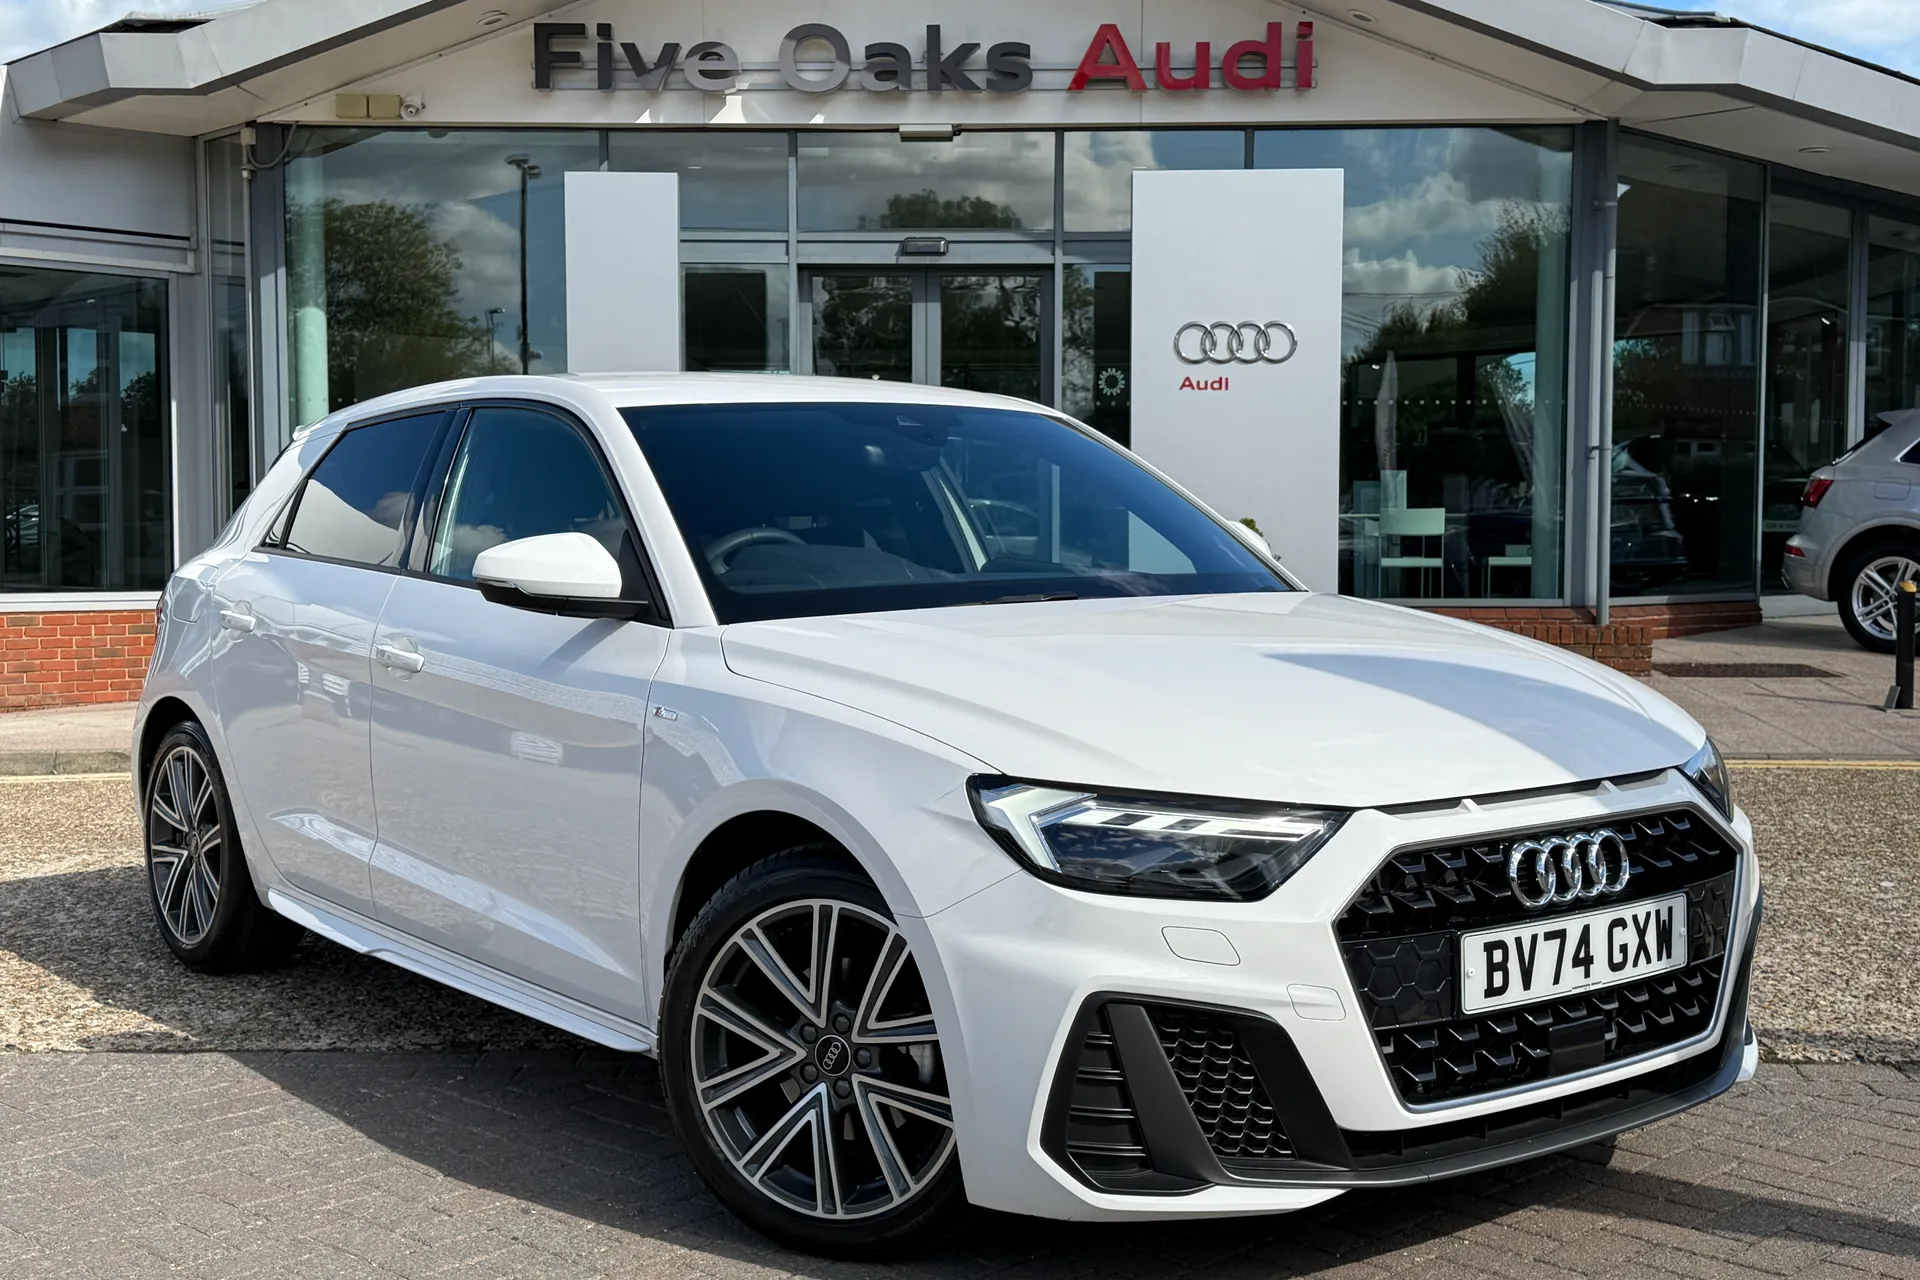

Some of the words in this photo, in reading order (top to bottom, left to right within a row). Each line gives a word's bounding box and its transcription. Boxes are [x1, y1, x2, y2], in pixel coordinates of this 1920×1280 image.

[534, 23, 740, 92] Five
[779, 23, 1033, 93] Oaks
[1066, 21, 1314, 92] Audi
[1179, 376, 1229, 391] Audi
[1483, 923, 1595, 999] BV74
[1607, 905, 1673, 973] GXW
